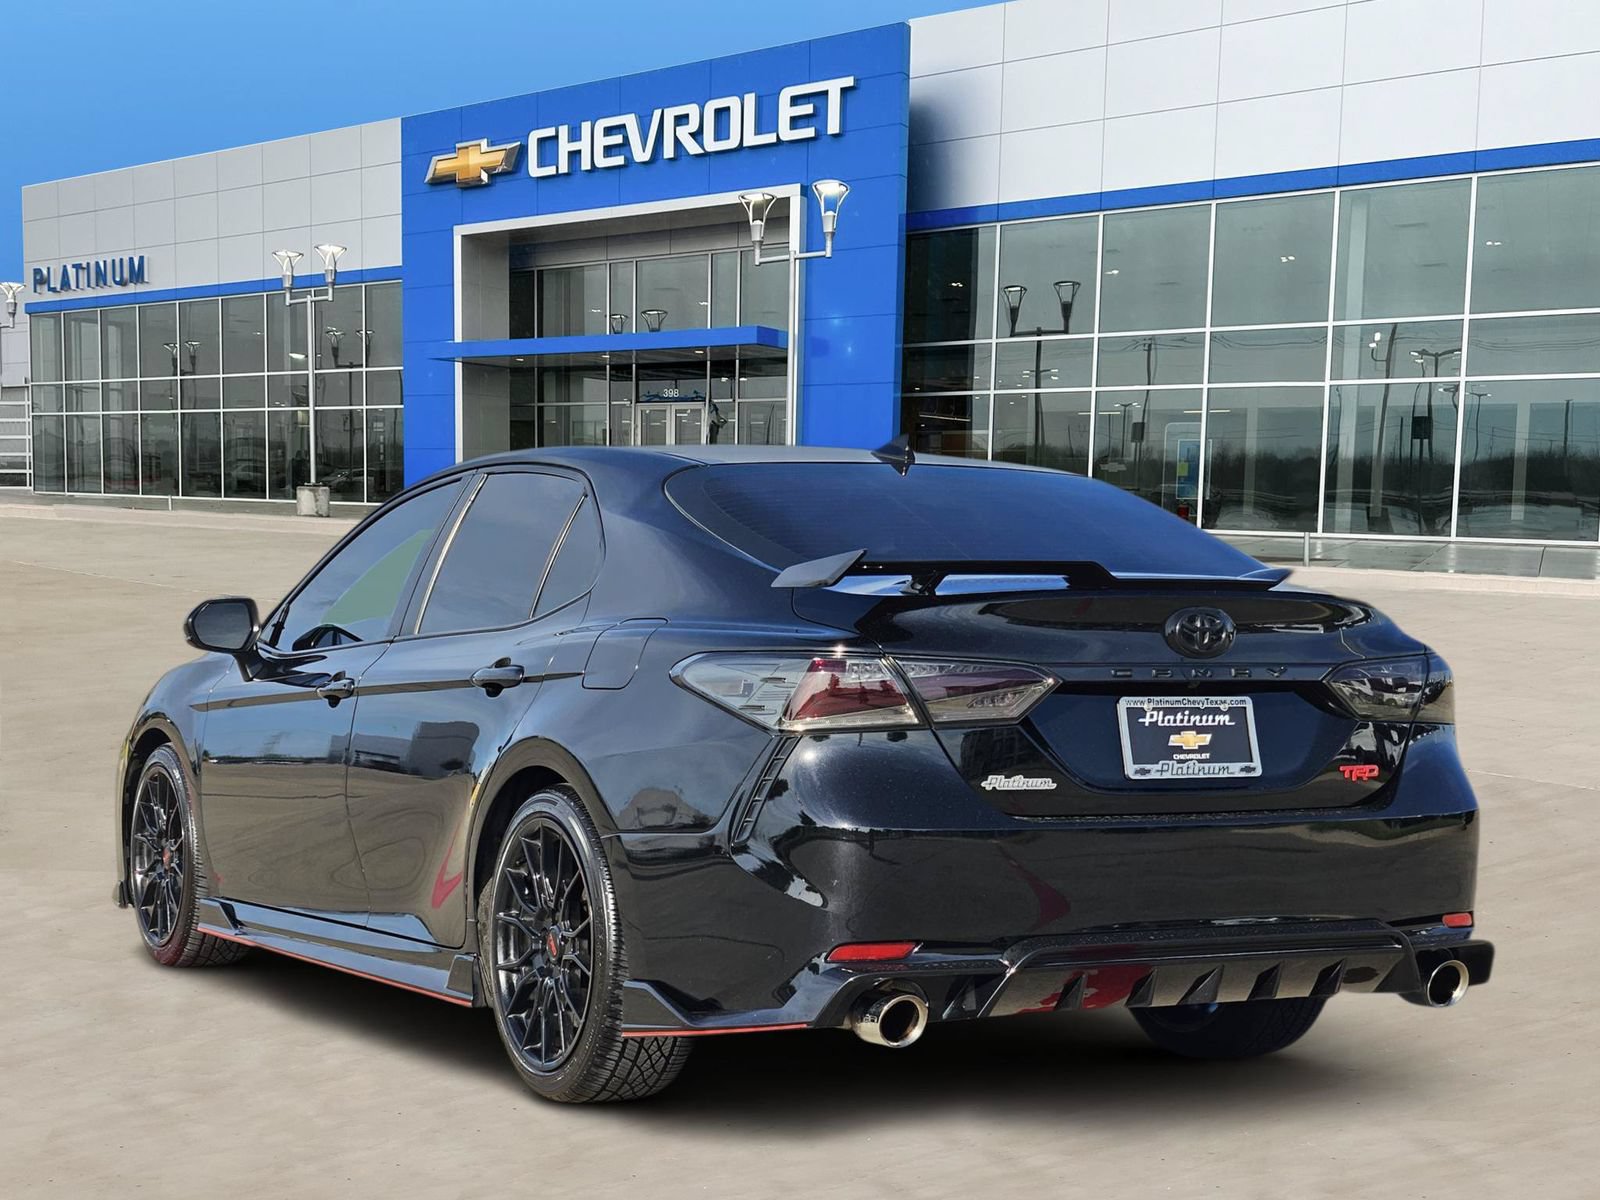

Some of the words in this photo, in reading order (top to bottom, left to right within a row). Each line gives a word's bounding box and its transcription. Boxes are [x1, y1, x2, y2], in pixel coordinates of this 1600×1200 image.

[527, 75, 856, 178] CHEVROLET
[33, 255, 145, 293] PLATINUM
[663, 388, 679, 397] 398
[1125, 698, 1246, 707] wwwPlatinumChevyTexas.com
[1138, 711, 1236, 726] Platinum
[1156, 762, 1236, 776] Platinum
[1339, 765, 1379, 781] TRD
[981, 775, 1057, 790] Platinum
